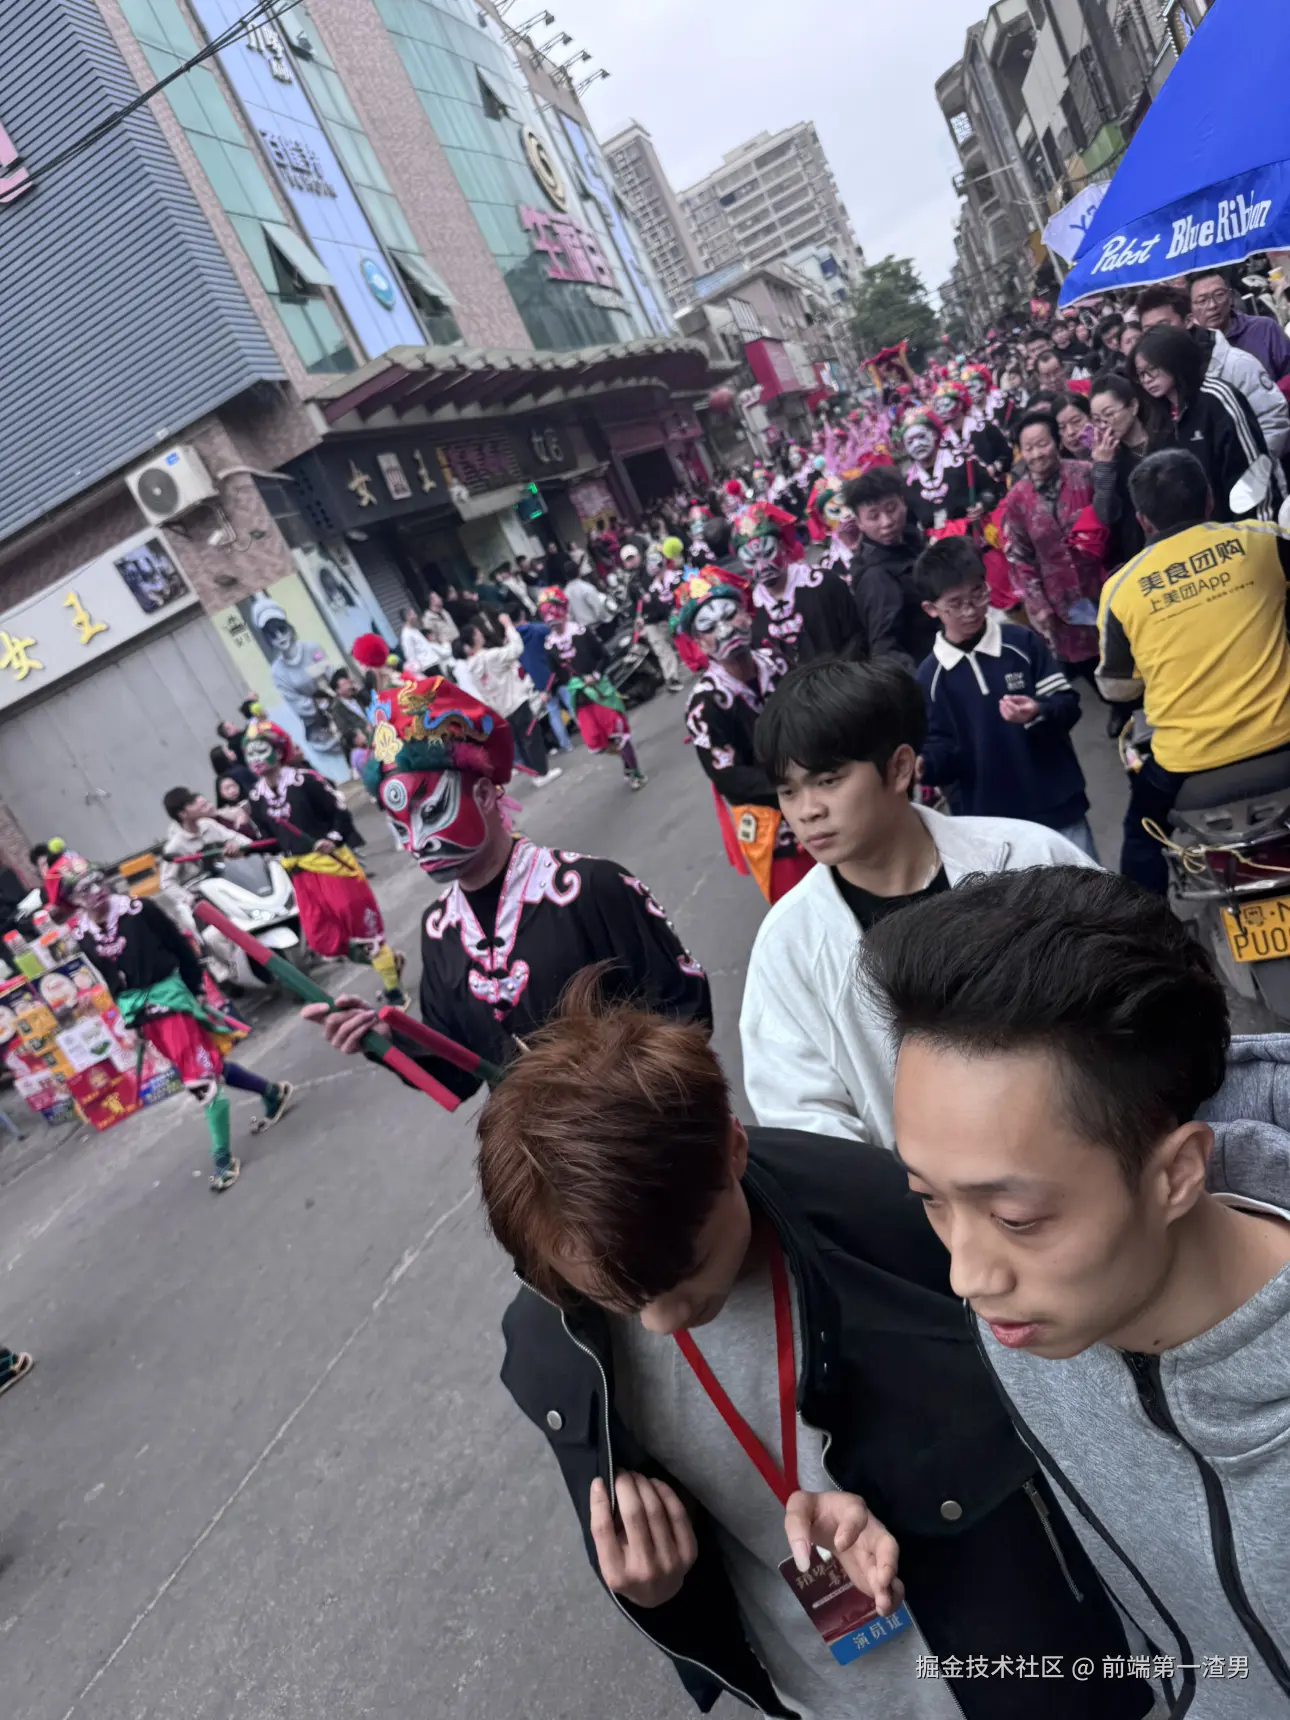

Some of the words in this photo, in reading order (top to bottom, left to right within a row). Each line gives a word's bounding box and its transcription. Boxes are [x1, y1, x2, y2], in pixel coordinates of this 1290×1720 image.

[1091, 234, 1160, 275] Pabst
[1165, 214, 1215, 260] Blue
[1215, 190, 1272, 244] Ribon
[1138, 538, 1246, 598] 美食团购
[1149, 571, 1231, 616] 上美团App
[1233, 926, 1290, 959] PU0
[852, 1612, 904, 1650] 演员证
